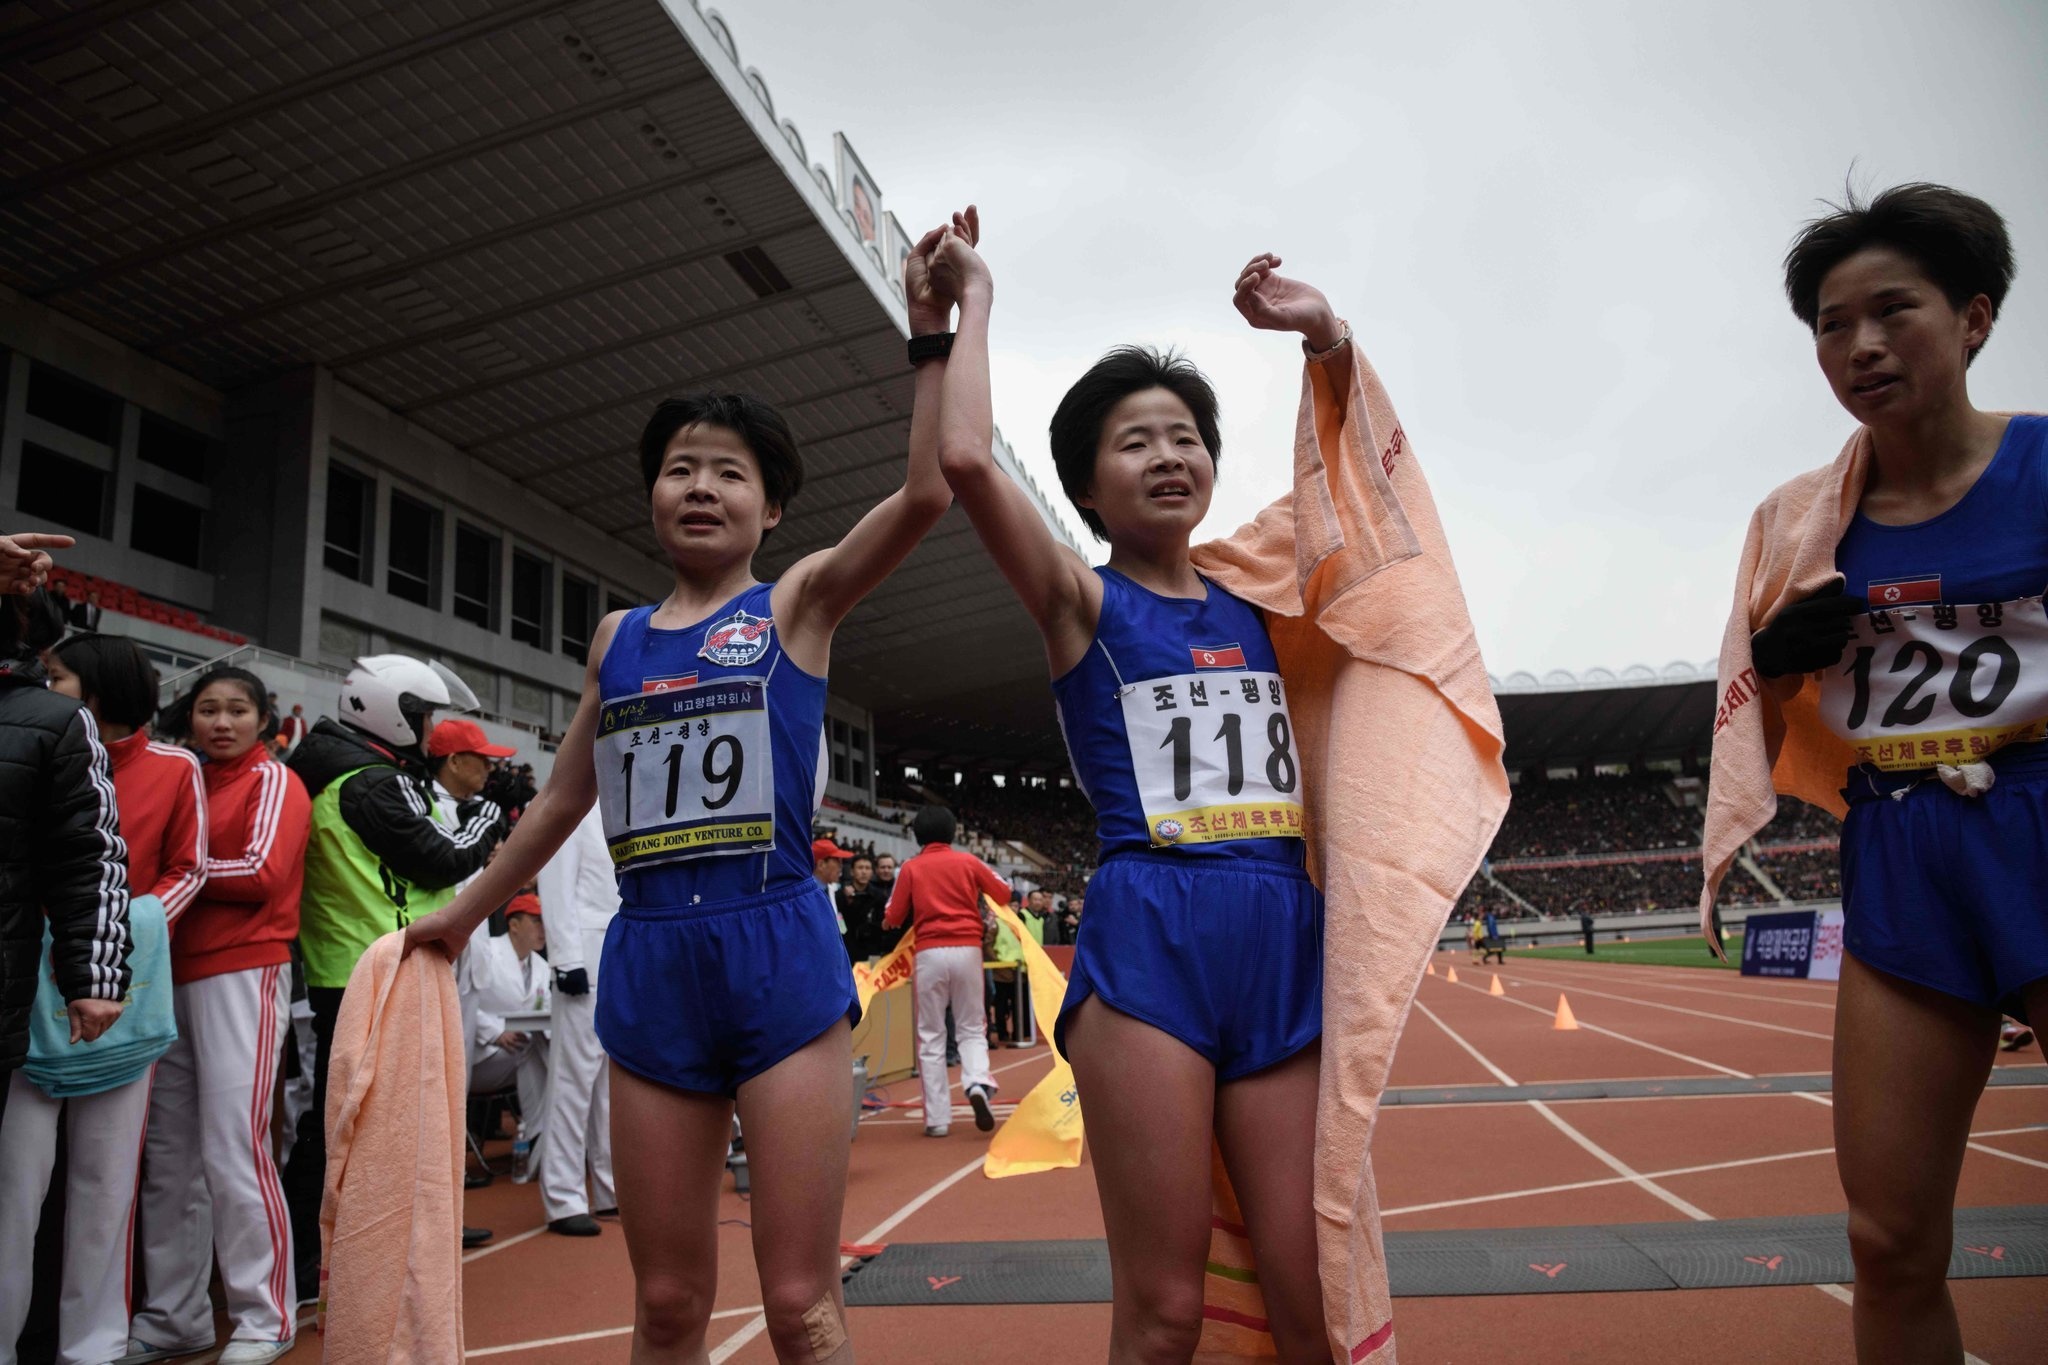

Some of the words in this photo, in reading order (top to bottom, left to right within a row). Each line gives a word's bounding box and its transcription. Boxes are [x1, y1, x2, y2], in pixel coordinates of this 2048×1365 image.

[1844, 635, 2021, 731] 120
[621, 734, 744, 827] 119
[1159, 712, 1297, 802] 118
[663, 833, 691, 846] JOINT
[694, 827, 743, 841] VENTURE
[747, 825, 764, 837] CO.
